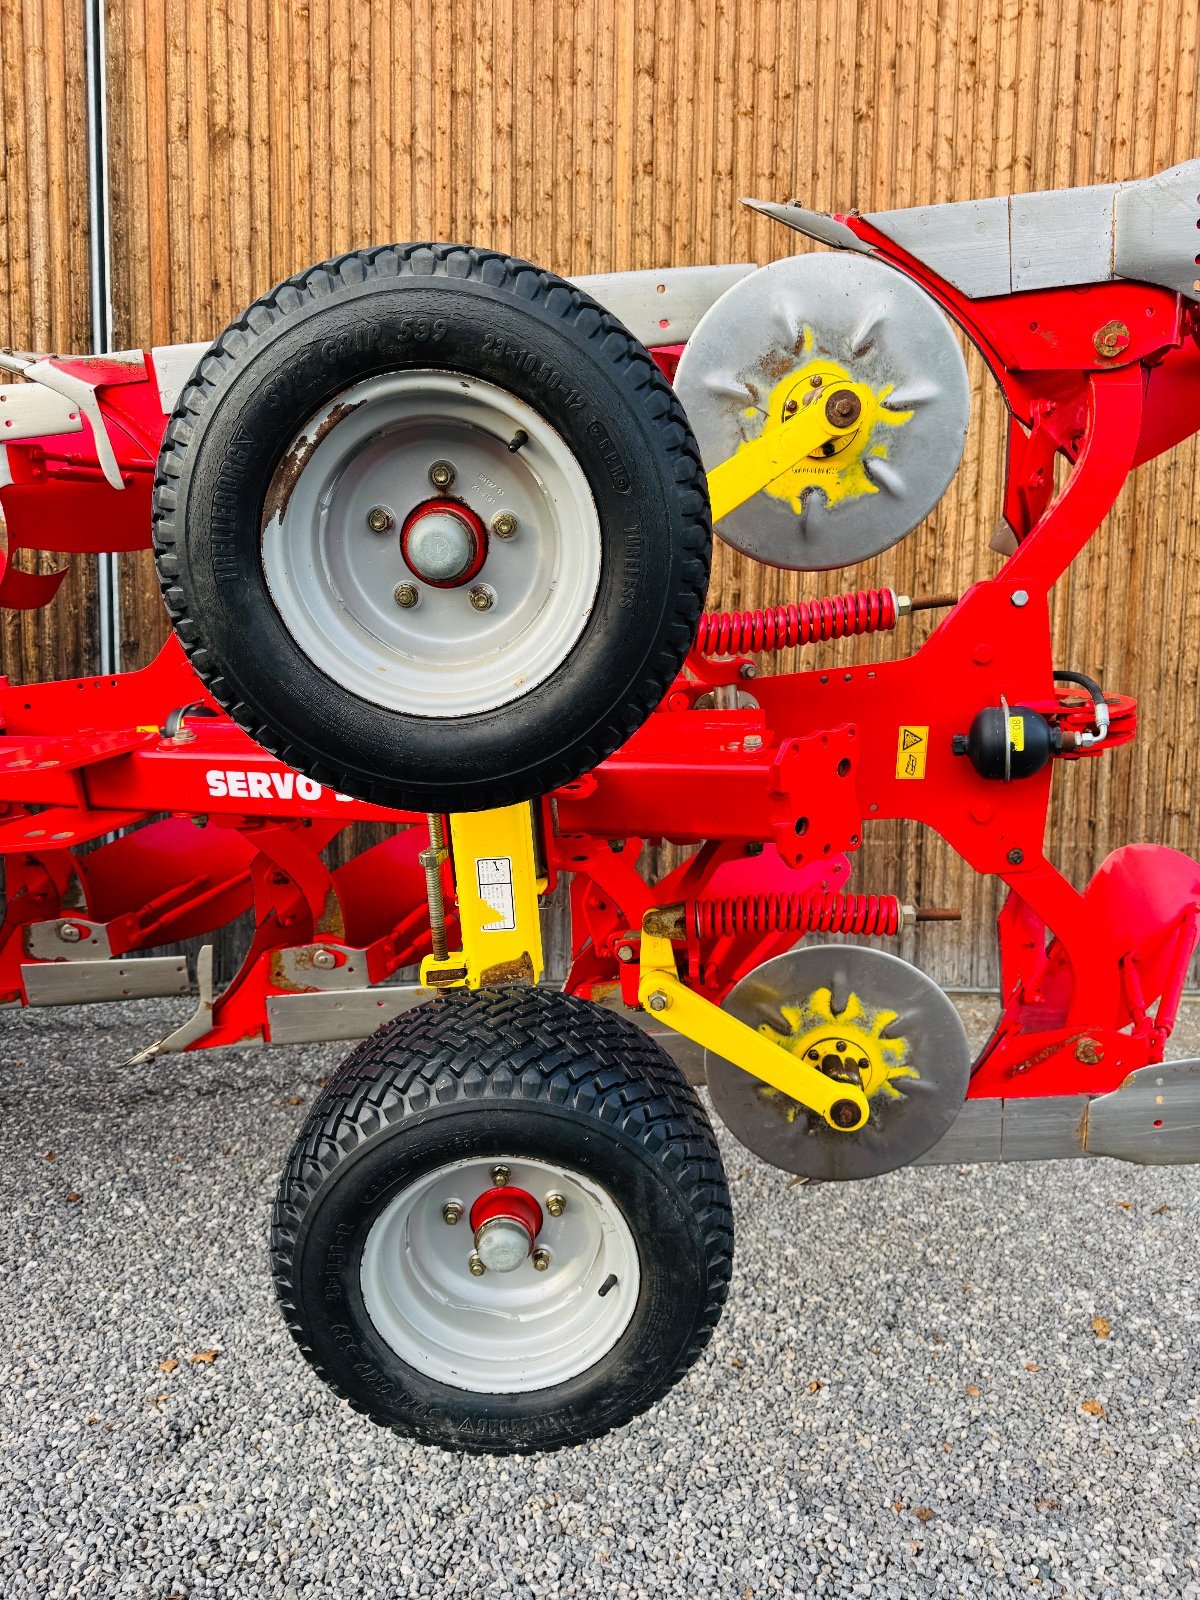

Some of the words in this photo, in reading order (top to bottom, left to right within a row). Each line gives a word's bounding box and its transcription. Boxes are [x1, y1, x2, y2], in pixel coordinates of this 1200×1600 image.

[321, 323, 383, 366] GRIP
[397, 317, 449, 343] 539
[210, 446, 249, 584] TRELLEBORG
[205, 769, 322, 801] SERVO
